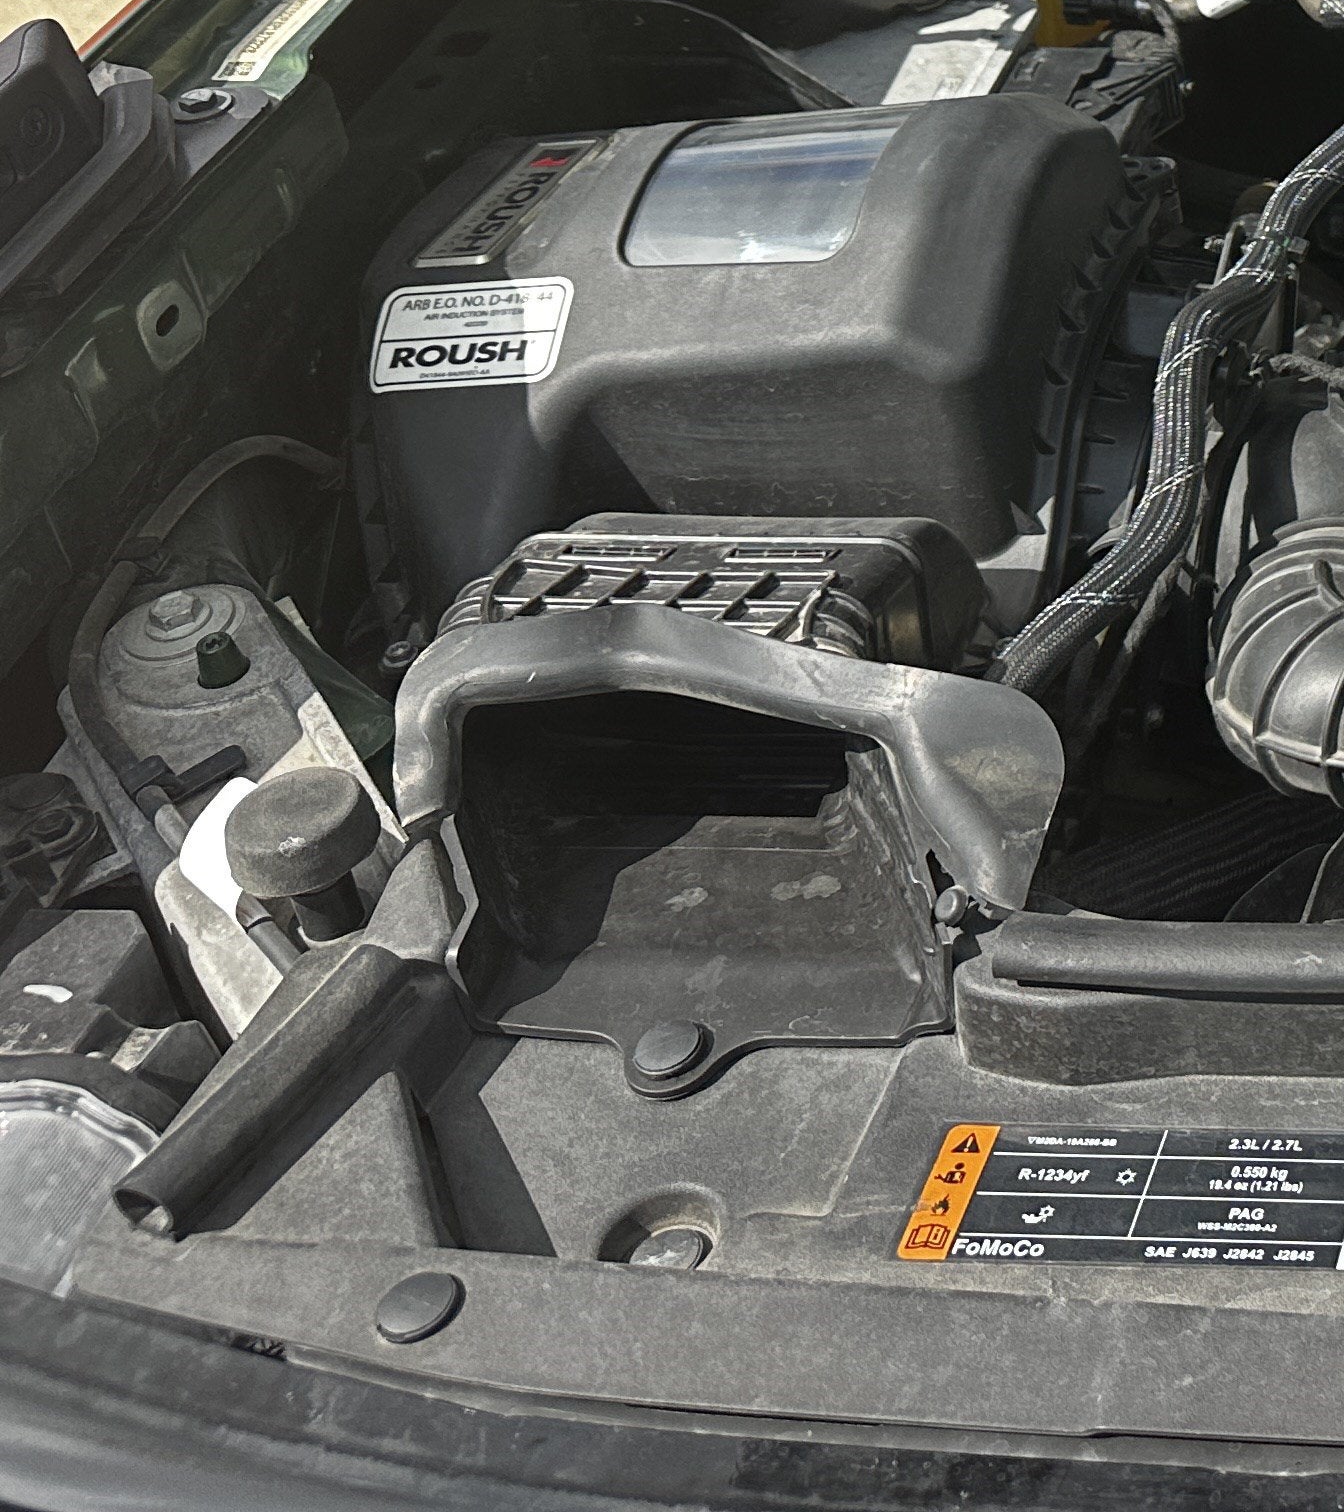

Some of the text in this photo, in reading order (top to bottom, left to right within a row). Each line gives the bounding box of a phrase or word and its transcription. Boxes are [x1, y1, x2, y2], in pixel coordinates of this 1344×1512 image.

[453, 171, 558, 252] ROUSH
[461, 296, 485, 308] NO.
[389, 339, 528, 369] ROUSH
[1228, 1138, 1260, 1151] 2.3L
[1271, 1139, 1303, 1152] 2.7L
[1018, 1168, 1090, 1185] R-1234yf
[1230, 1166, 1289, 1181] 0.550 kg
[1228, 1208, 1265, 1221] PAG
[951, 1238, 1045, 1258] FoMoCo
[1144, 1246, 1315, 1262] SAE J639 J2842 J2845
